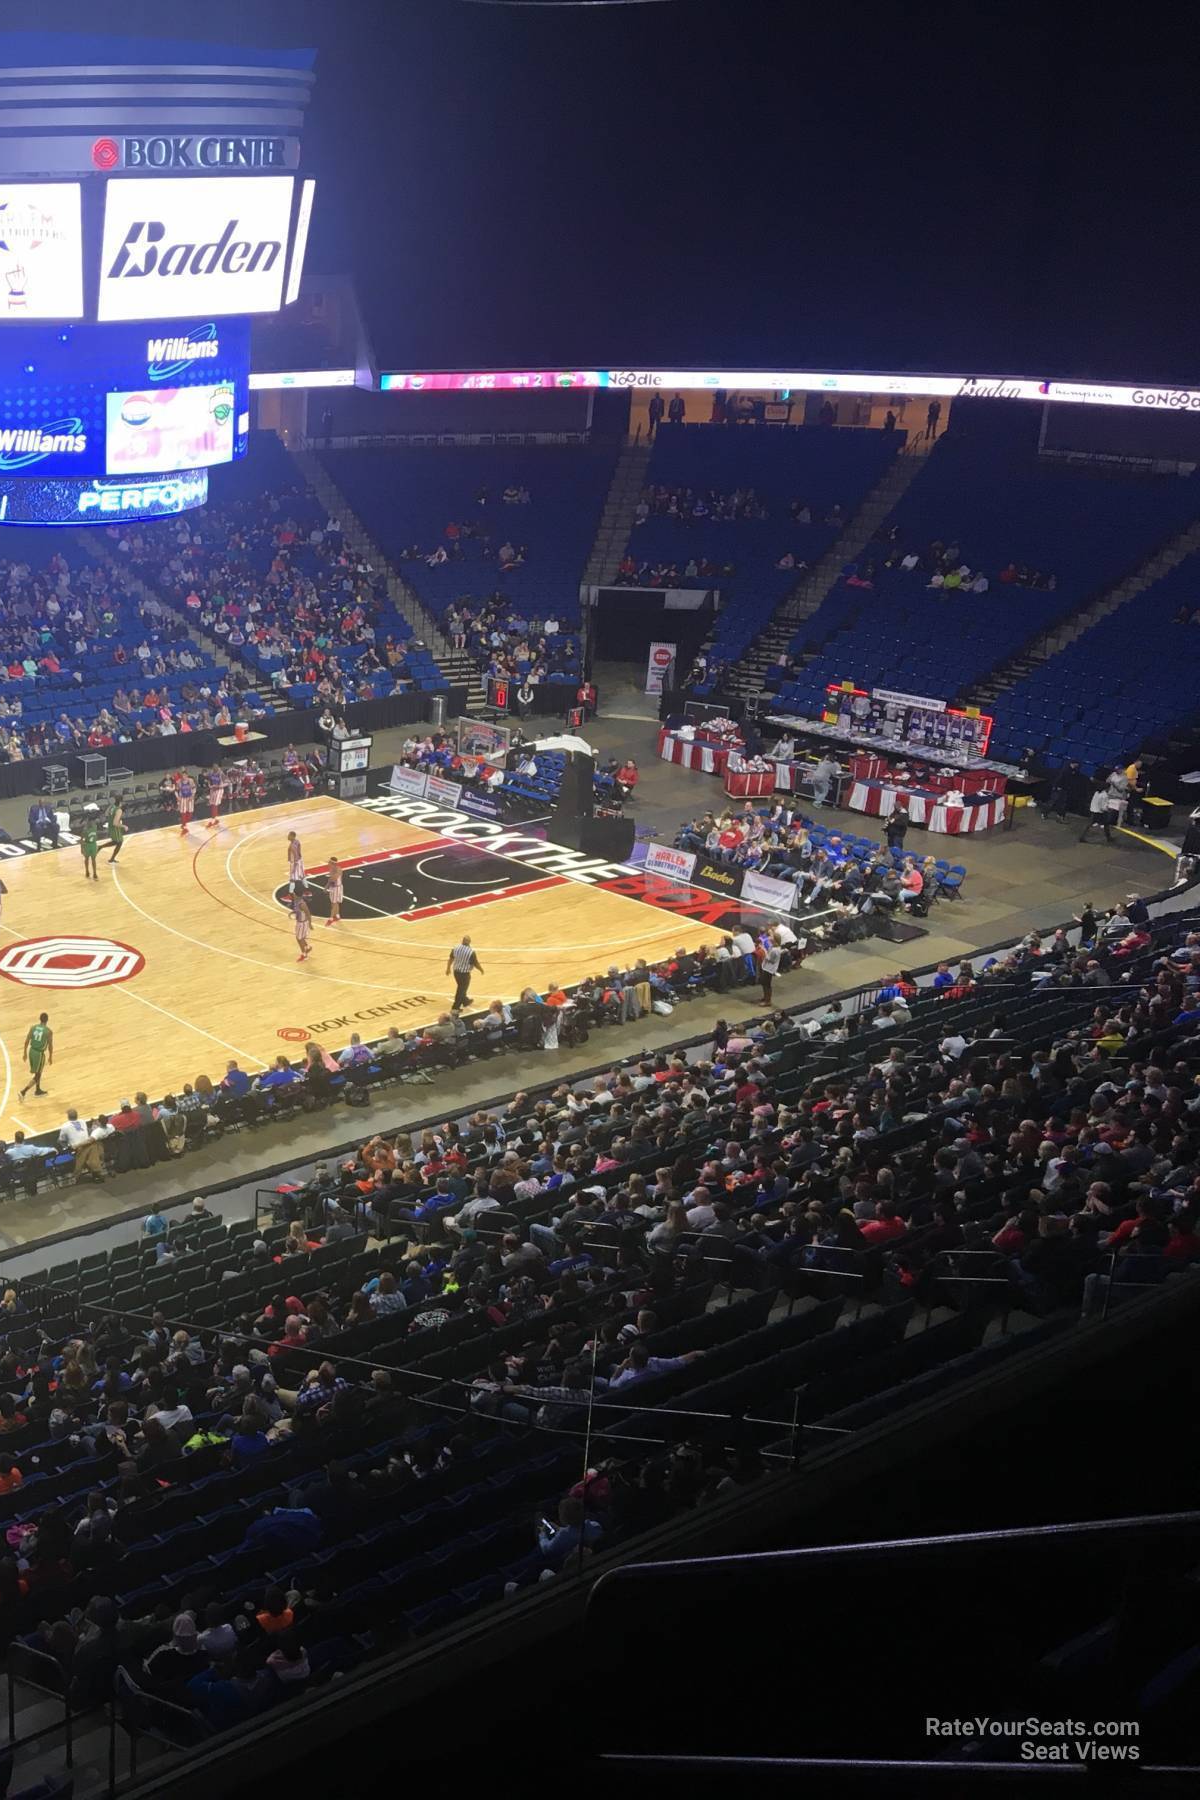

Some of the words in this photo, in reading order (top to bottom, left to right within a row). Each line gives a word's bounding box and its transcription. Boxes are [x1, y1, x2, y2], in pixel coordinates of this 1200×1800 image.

[124, 137, 194, 168] BOK
[196, 136, 287, 168] CENTER
[107, 219, 283, 279] Baden
[147, 338, 219, 363] Williams
[354, 793, 643, 883] #ROCKTHE
[595, 874, 765, 924] BOK
[655, 849, 687, 867] HARLEM
[700, 865, 735, 886] Baden
[307, 1015, 355, 1034] BOK
[354, 995, 437, 1021] CENTER
